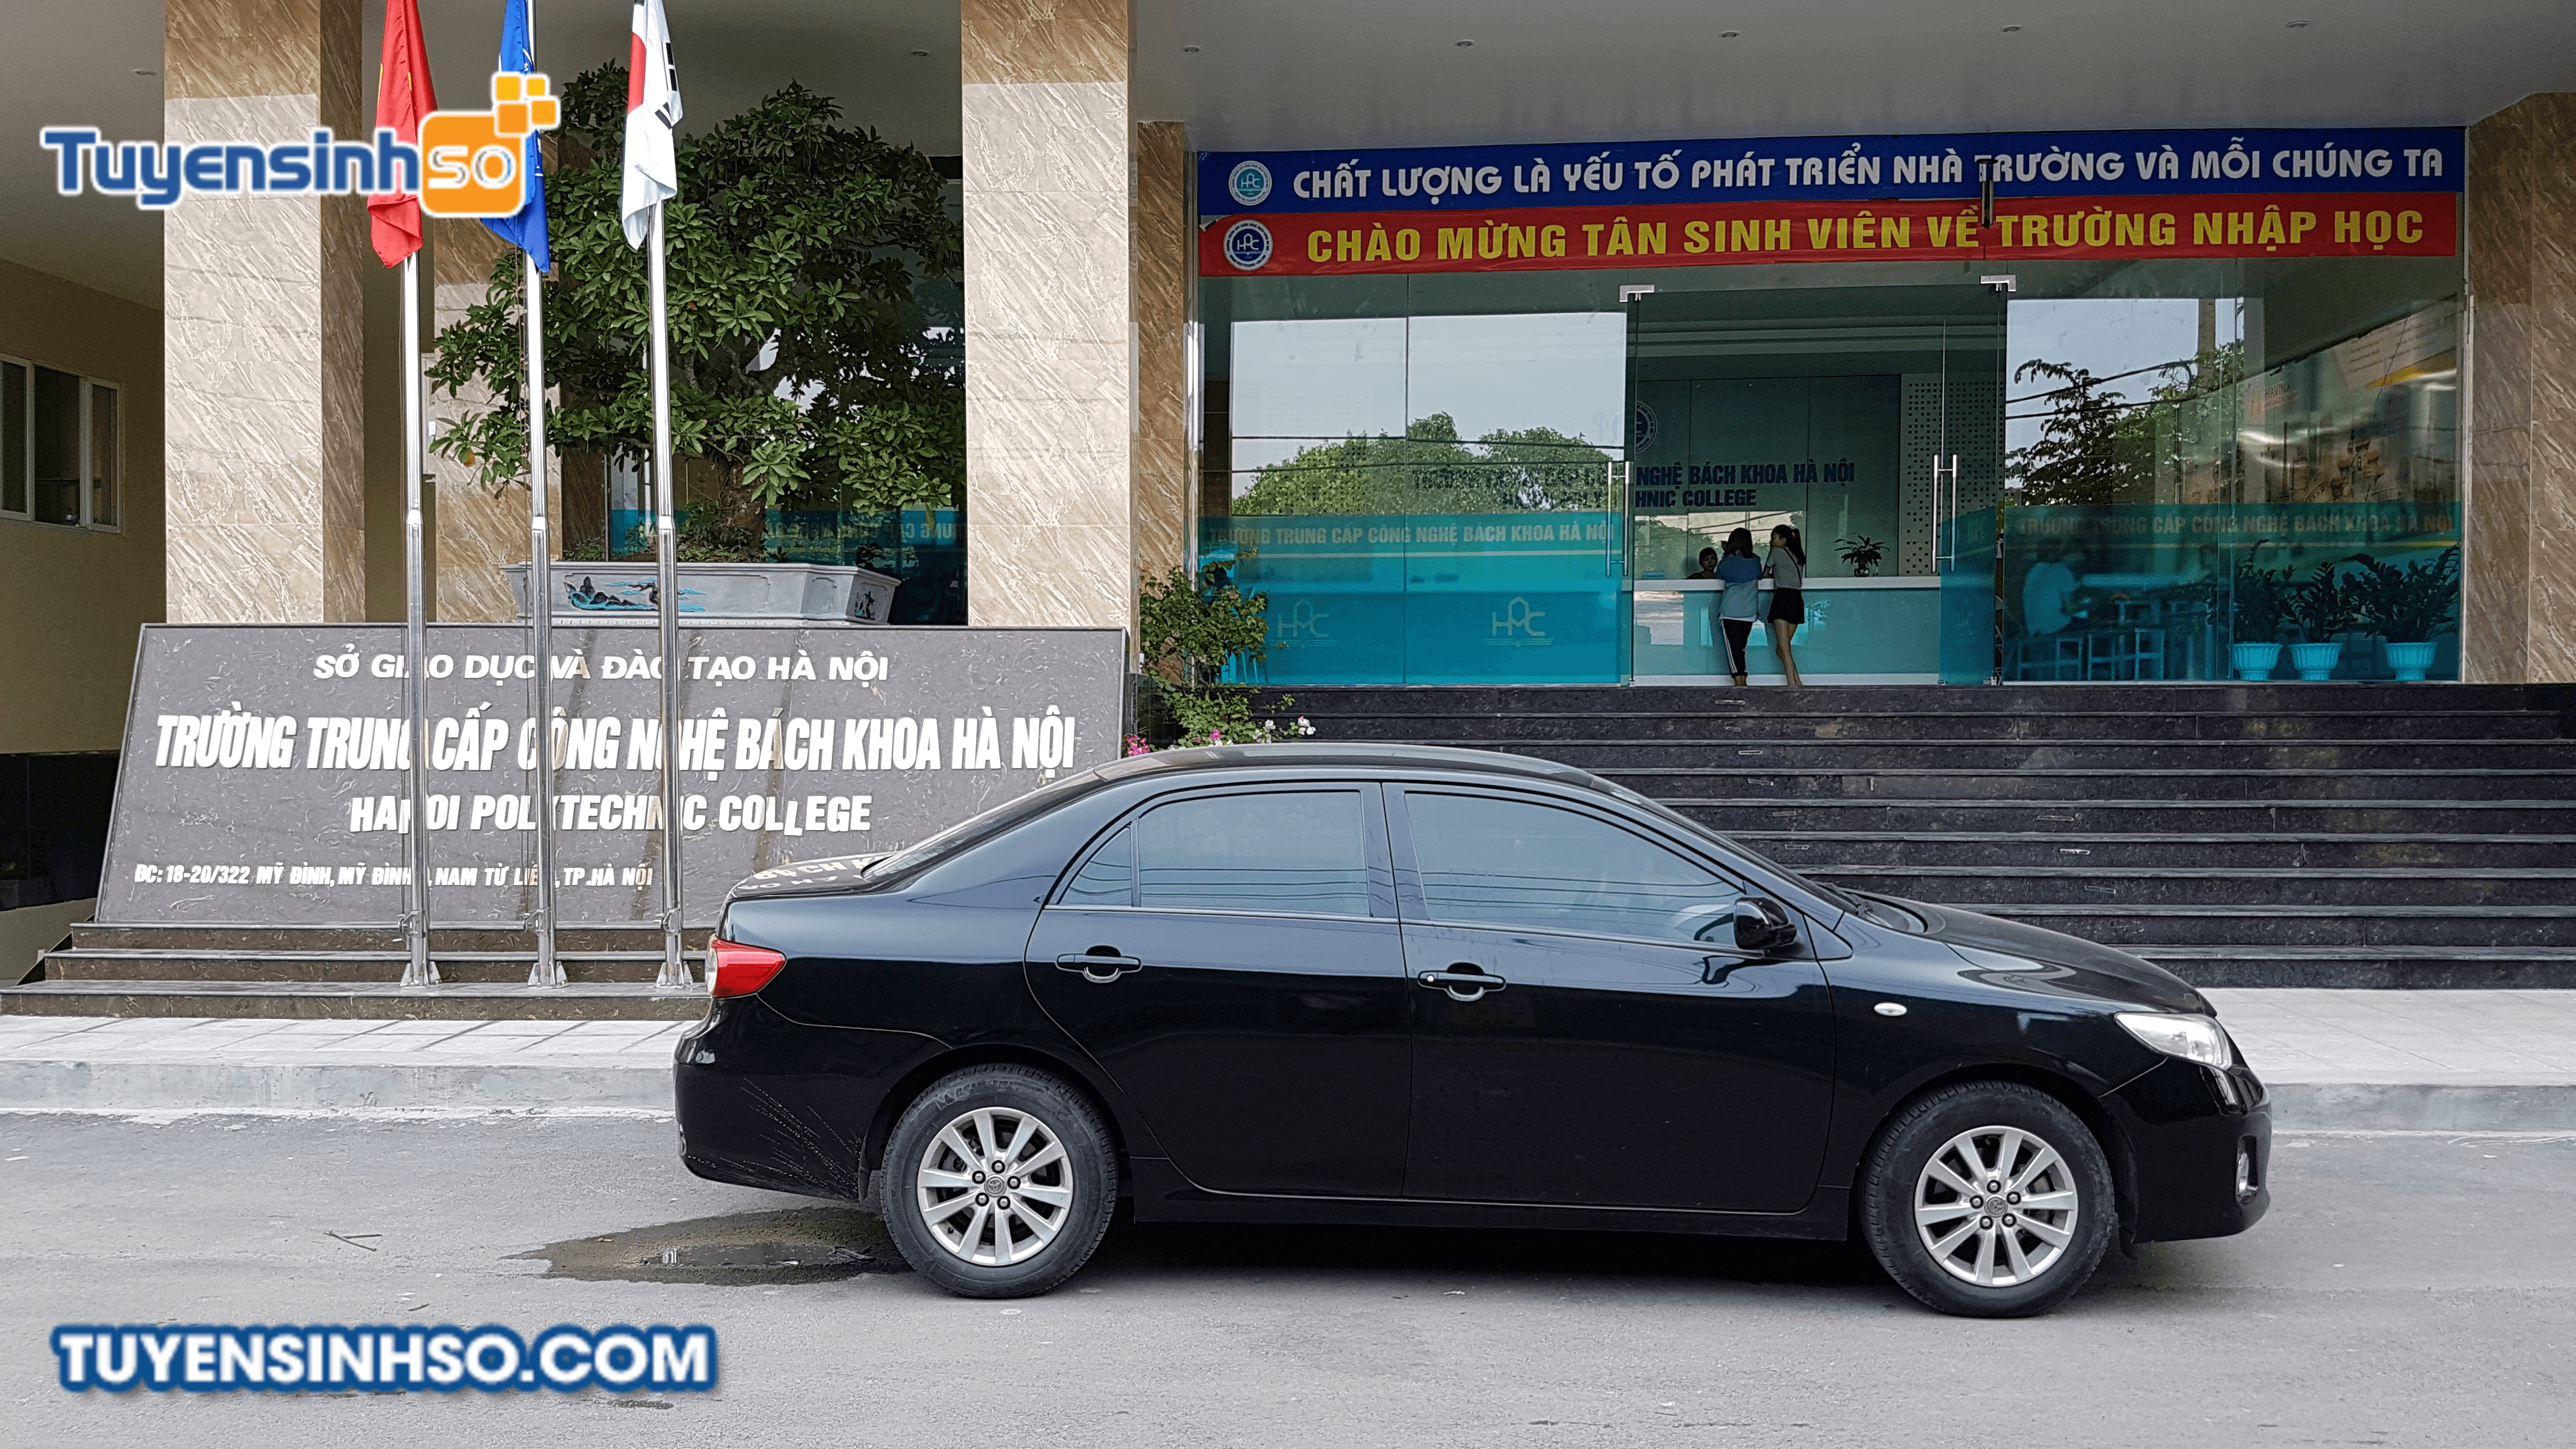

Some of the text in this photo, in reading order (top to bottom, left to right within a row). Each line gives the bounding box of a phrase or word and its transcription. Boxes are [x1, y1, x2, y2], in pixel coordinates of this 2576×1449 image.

[1294, 136, 2443, 204] CHẤT LƯỢNG LÀ YẾU TỐ PHÁT TRIỂN NHÀ TRƯỜNG VÀ MỖI CHÚNG TA
[1308, 204, 2423, 263] CHÀO MỪNG TÂN SINH VIÊN VỀ TRƯỜNG NHẬP HỌC
[1636, 457, 1855, 489] NGHỆ BÁCH KHOA HÀ NỘI
[1682, 489, 1757, 507] COLLEGE
[1275, 527, 1327, 544] TRUNG
[1331, 522, 1364, 544] CẤP
[1367, 523, 1411, 543] CÔNG
[1416, 523, 1459, 546] NGHỆ
[1462, 523, 1507, 542] BÁCH
[1510, 525, 1555, 542] KHOA
[1558, 520, 1582, 541] HÀ
[314, 643, 360, 680] SỞ
[371, 654, 454, 679] GIO
[464, 654, 538, 687] DỤC
[550, 648, 591, 679] VÀ
[687, 656, 756, 687] TẠO
[767, 650, 817, 680] HÀ
[829, 650, 889, 688] NỘI
[155, 700, 297, 769] TRƯỜNG
[432, 701, 510, 770] CẤP
[518, 706, 622, 770] CÔNG
[626, 707, 729, 781] NHỆ
[735, 707, 835, 771] BÁCH
[842, 717, 941, 770] KHOA
[951, 706, 1002, 770] HÀ
[1011, 704, 1077, 779] NỘI
[470, 793, 708, 831] POLTECHNC
[718, 794, 873, 836] COLLEGE
[134, 864, 164, 883] ĐC:
[166, 864, 250, 884] 18-20/322
[256, 861, 285, 884] MỸ
[289, 861, 336, 887] ĐÌNH,
[337, 862, 367, 885] MỸ
[434, 867, 478, 885] NAM
[485, 862, 510, 885] TỪ
[514, 863, 560, 889] LIÊ,
[622, 863, 653, 891] NỘI
